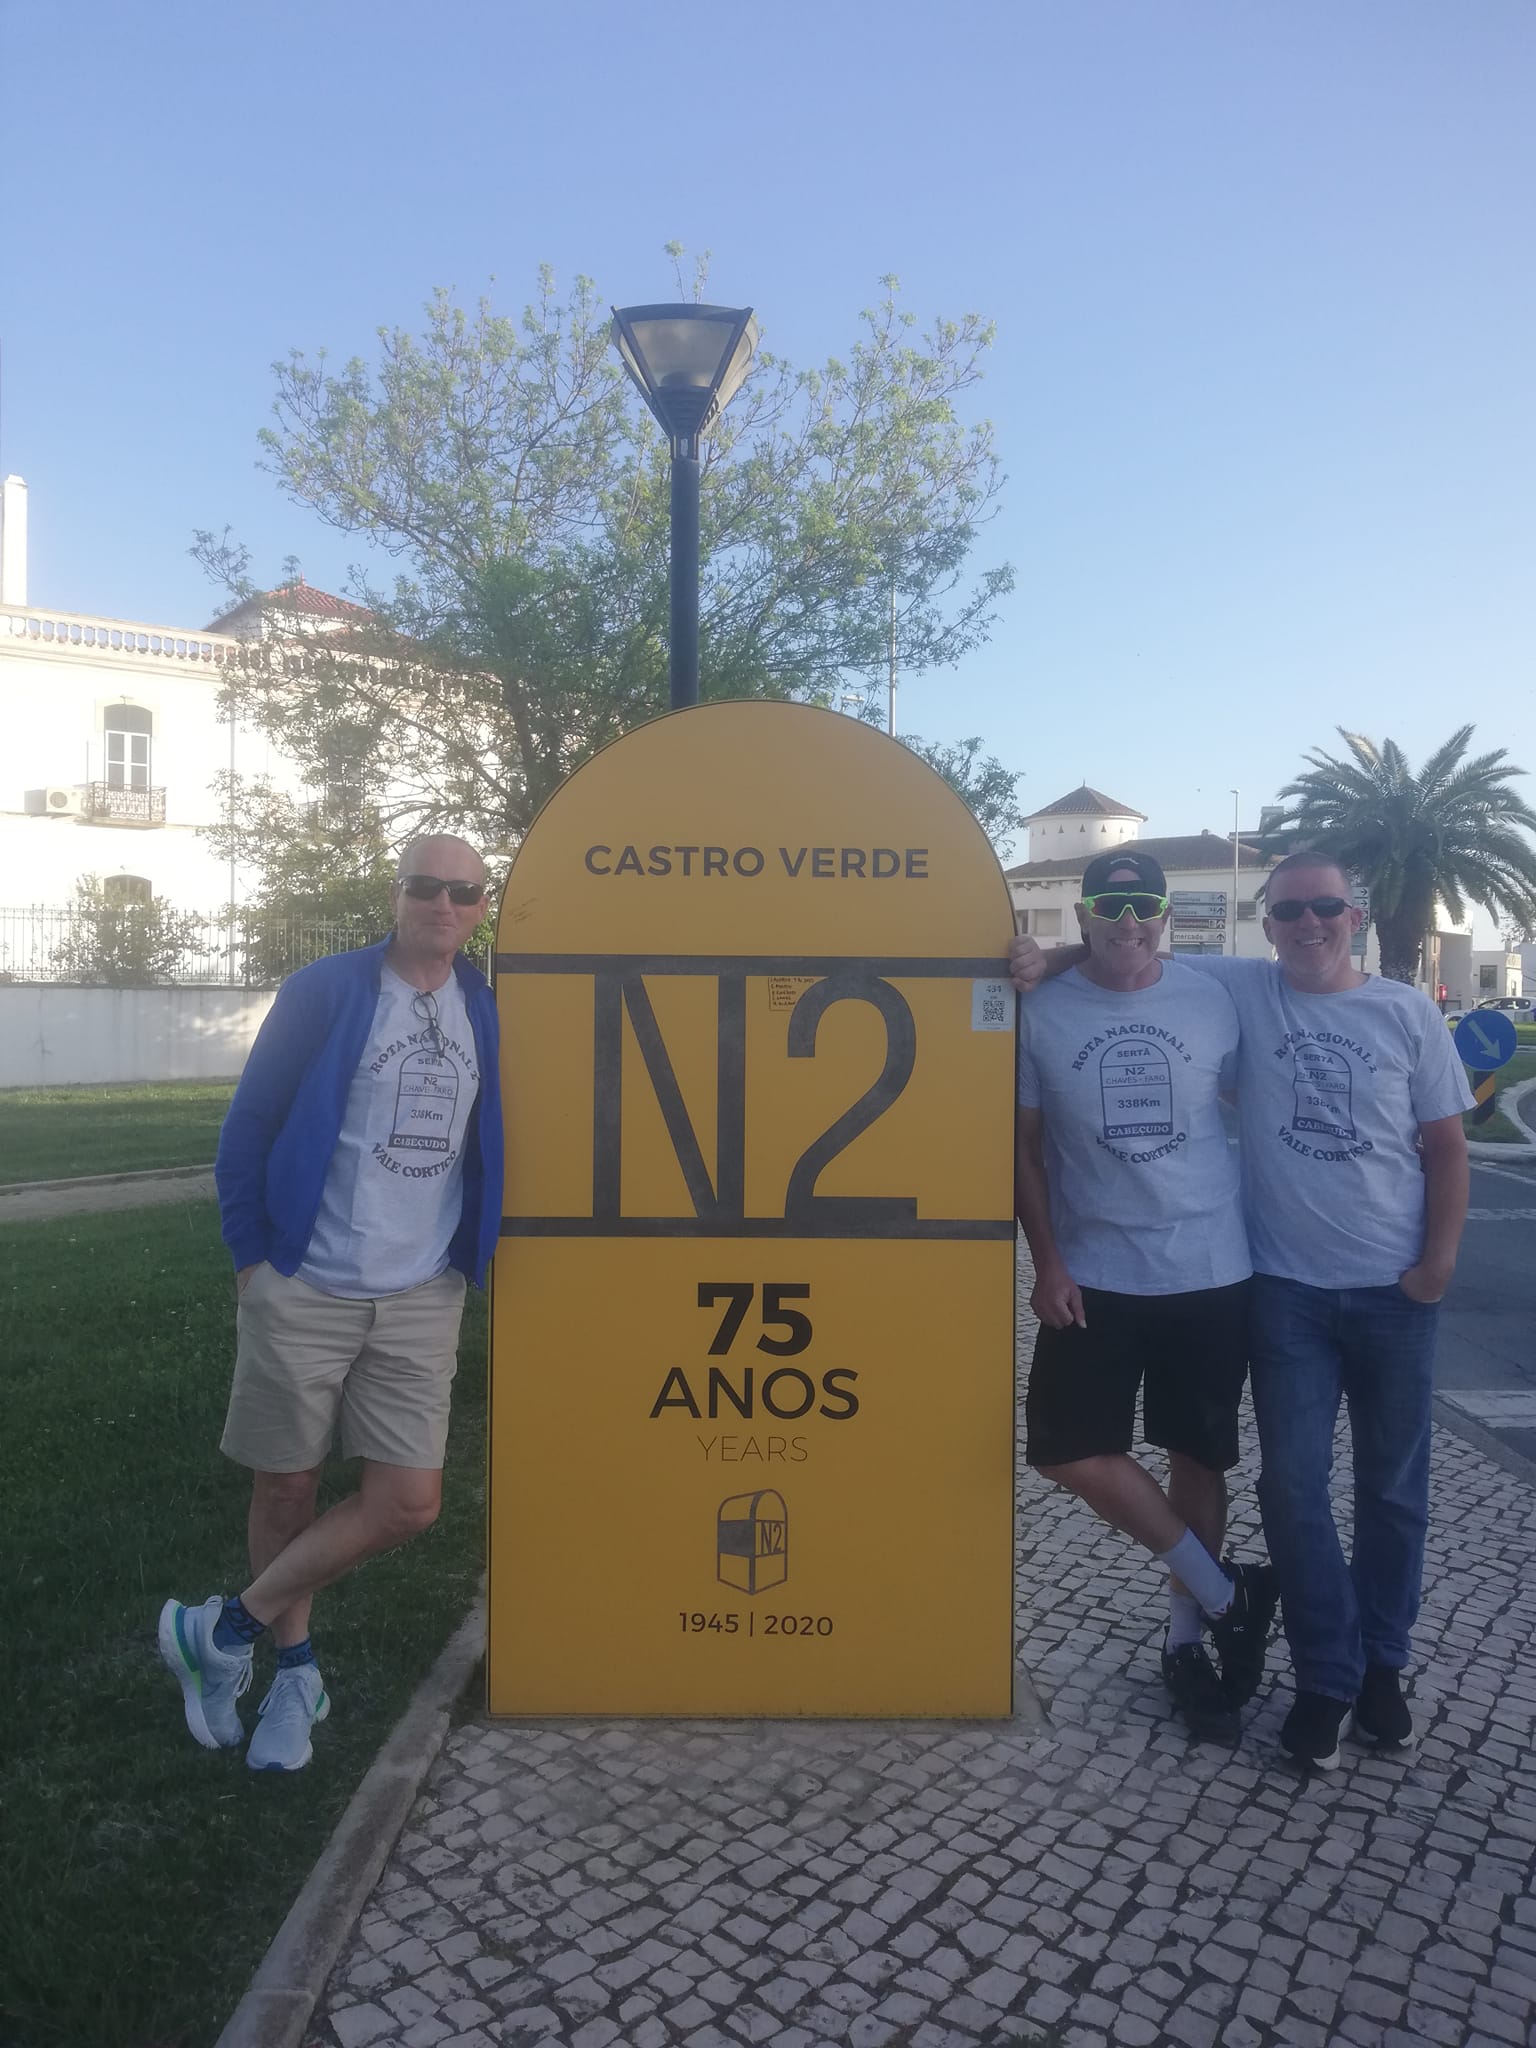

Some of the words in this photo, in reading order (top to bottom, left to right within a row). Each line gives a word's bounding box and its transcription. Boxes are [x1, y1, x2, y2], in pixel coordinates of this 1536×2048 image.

[585, 845, 765, 878] CASTRO
[779, 847, 929, 879] VERDE
[370, 1040, 407, 1074] ROTA
[1072, 1036, 1105, 1071] ROTA
[1105, 1024, 1185, 1054] NACIONAL
[1182, 1053, 1192, 1063] 2
[1296, 1029, 1373, 1064] NACIONAL
[423, 1076, 438, 1086] N2
[1125, 1066, 1146, 1076] N2
[1309, 1070, 1327, 1081] N2
[593, 954, 919, 1236] N2
[1118, 1099, 1161, 1109] 338Km
[1108, 1125, 1169, 1137] CABEÇUDO
[1278, 1126, 1312, 1157] VALE
[371, 1142, 401, 1174] VALE
[1096, 1135, 1128, 1162] VALE
[1131, 1131, 1186, 1164] CORTIÇO
[697, 1282, 813, 1357] 75
[649, 1367, 860, 1420] ANOS
[697, 1435, 809, 1462] YEARS
[760, 1523, 783, 1556] N2
[679, 1612, 739, 1634] 1945
[764, 1615, 833, 1637] 2020
